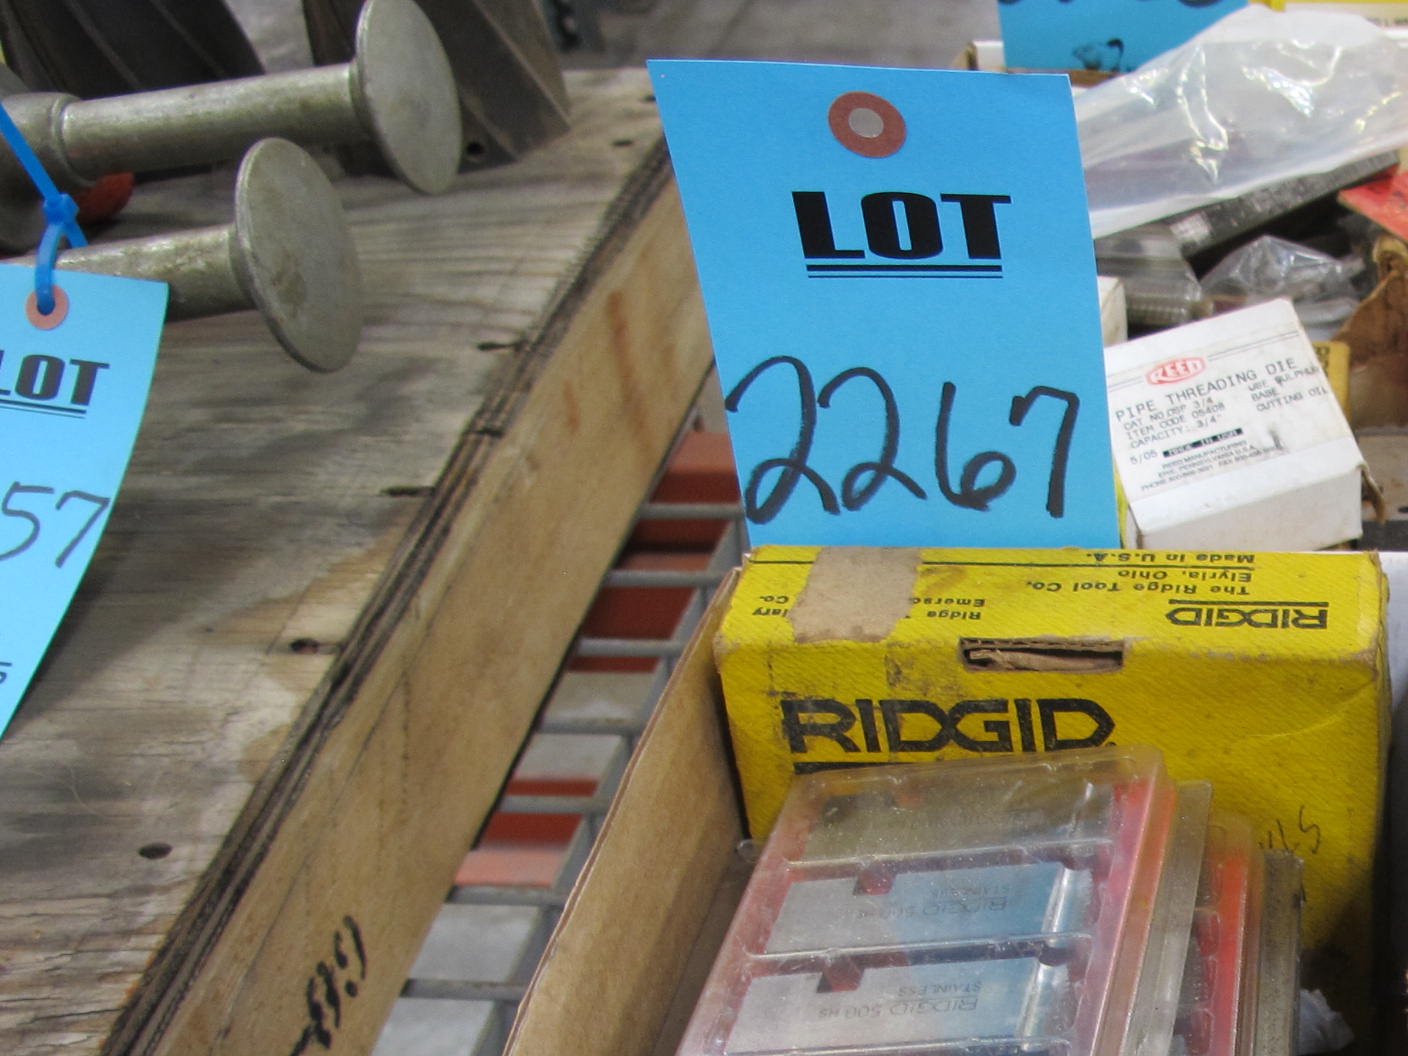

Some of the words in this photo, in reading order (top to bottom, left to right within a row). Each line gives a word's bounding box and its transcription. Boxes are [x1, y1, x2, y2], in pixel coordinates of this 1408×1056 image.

[791, 190, 1012, 260] LOT
[0, 349, 110, 407] OT
[1147, 358, 1205, 385] REED
[1115, 399, 1157, 422] PIPE
[1165, 369, 1258, 405] THREADING
[1265, 356, 1298, 376] DIE
[1193, 396, 1214, 409] 3/4
[1256, 391, 1305, 412] CUTTING
[724, 355, 1081, 525] 2267
[1126, 424, 1155, 441] ITEM
[1086, 552, 1157, 564] U.S.A.
[1165, 553, 1186, 563] in
[1195, 553, 1256, 564] Made
[1117, 569, 1168, 581] Ohio
[1180, 569, 1253, 583] Elyria,
[1026, 579, 1064, 593] Co.
[1072, 580, 1122, 593] Tool
[1133, 580, 1198, 595] Ridge
[1209, 583, 1250, 596] The
[926, 609, 983, 621] Ridge
[1164, 606, 1329, 630] RIDGID
[778, 697, 1117, 755] RIDGID
[898, 981, 982, 997] STAINLESS
[818, 1008, 841, 1019] HS
[850, 1003, 881, 1019] 500
[890, 998, 978, 1017] RIDGID
